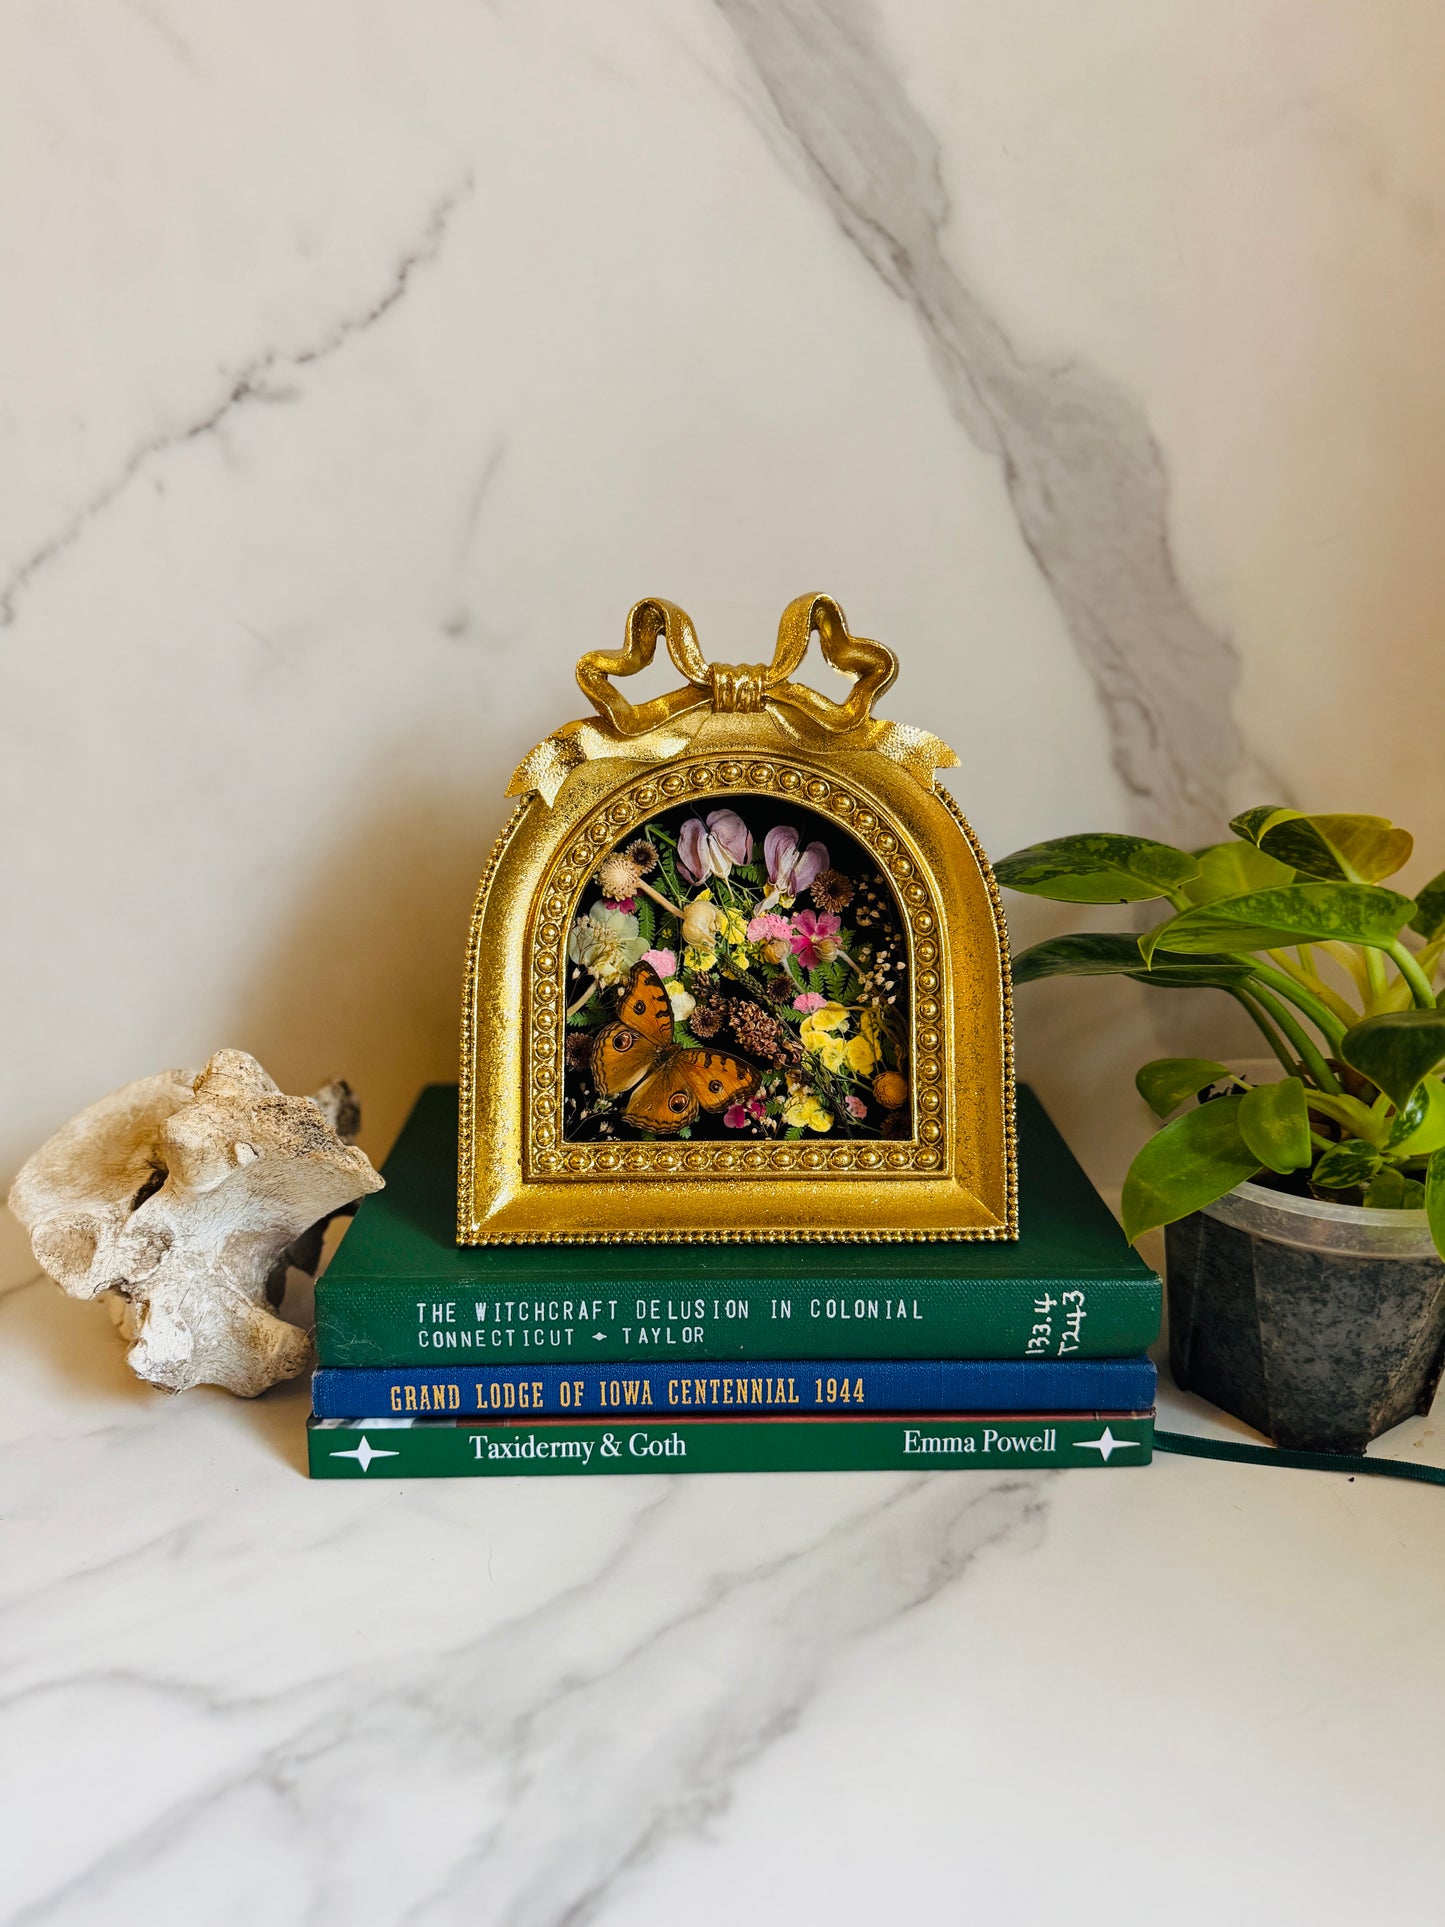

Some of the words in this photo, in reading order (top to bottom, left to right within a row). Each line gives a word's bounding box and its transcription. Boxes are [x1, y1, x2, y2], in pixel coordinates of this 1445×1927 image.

[416, 1302, 456, 1323] THE
[475, 1300, 618, 1322] WITCHCRAFT
[636, 1298, 749, 1320] DELUSION
[771, 1299, 791, 1319] IN
[810, 1298, 923, 1320] COLONIAL
[1025, 1292, 1058, 1354] 133.4
[1057, 1290, 1087, 1356] T243
[418, 1328, 574, 1348] CONNECTICUT
[622, 1326, 704, 1344] TAYLOR
[390, 1384, 460, 1411] GRAND
[475, 1381, 544, 1409] LODGE
[559, 1381, 584, 1407] OF
[599, 1379, 653, 1406] IOWA
[668, 1377, 800, 1405] CENTENNIAL
[815, 1377, 865, 1403] 1944
[469, 1434, 595, 1465] Taxidermy
[599, 1433, 622, 1457] &
[629, 1432, 686, 1457] Goth
[903, 1430, 976, 1453] Emma
[982, 1428, 1056, 1452] Powell
